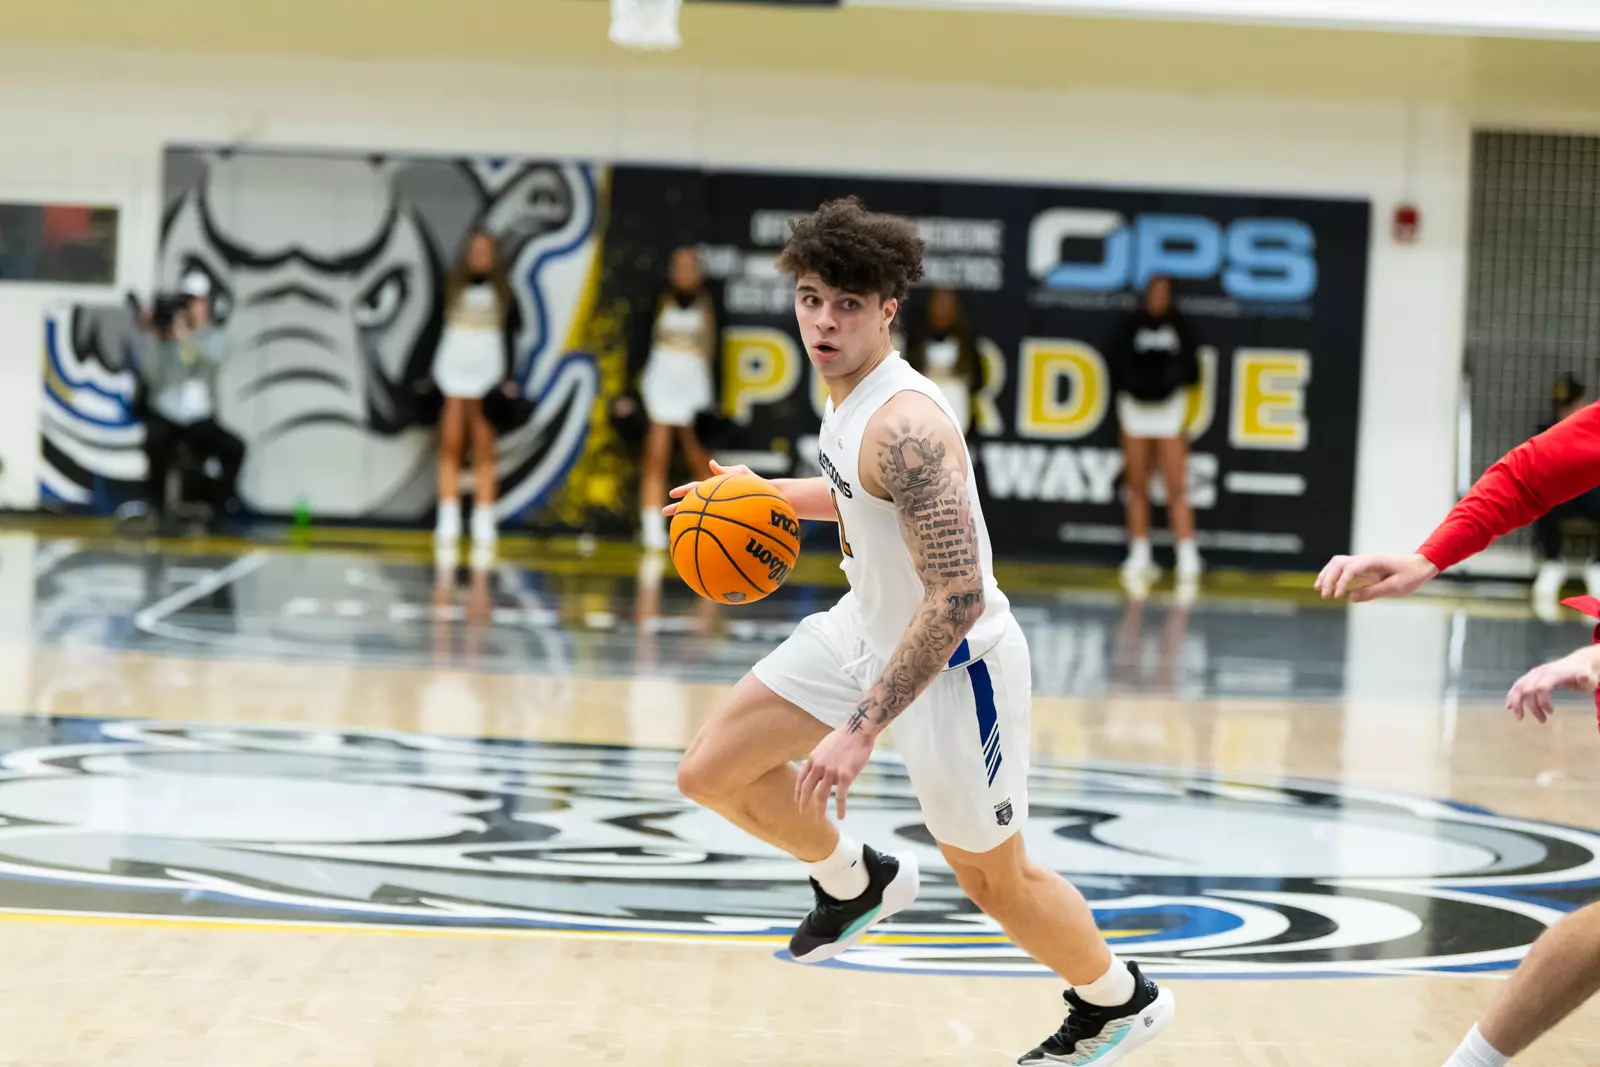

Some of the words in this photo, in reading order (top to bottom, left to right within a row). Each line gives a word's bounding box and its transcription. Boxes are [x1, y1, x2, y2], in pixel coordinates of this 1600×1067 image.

[721, 326, 1312, 450] PDE
[983, 442, 1218, 509] WAYE
[745, 537, 793, 585] ilson
